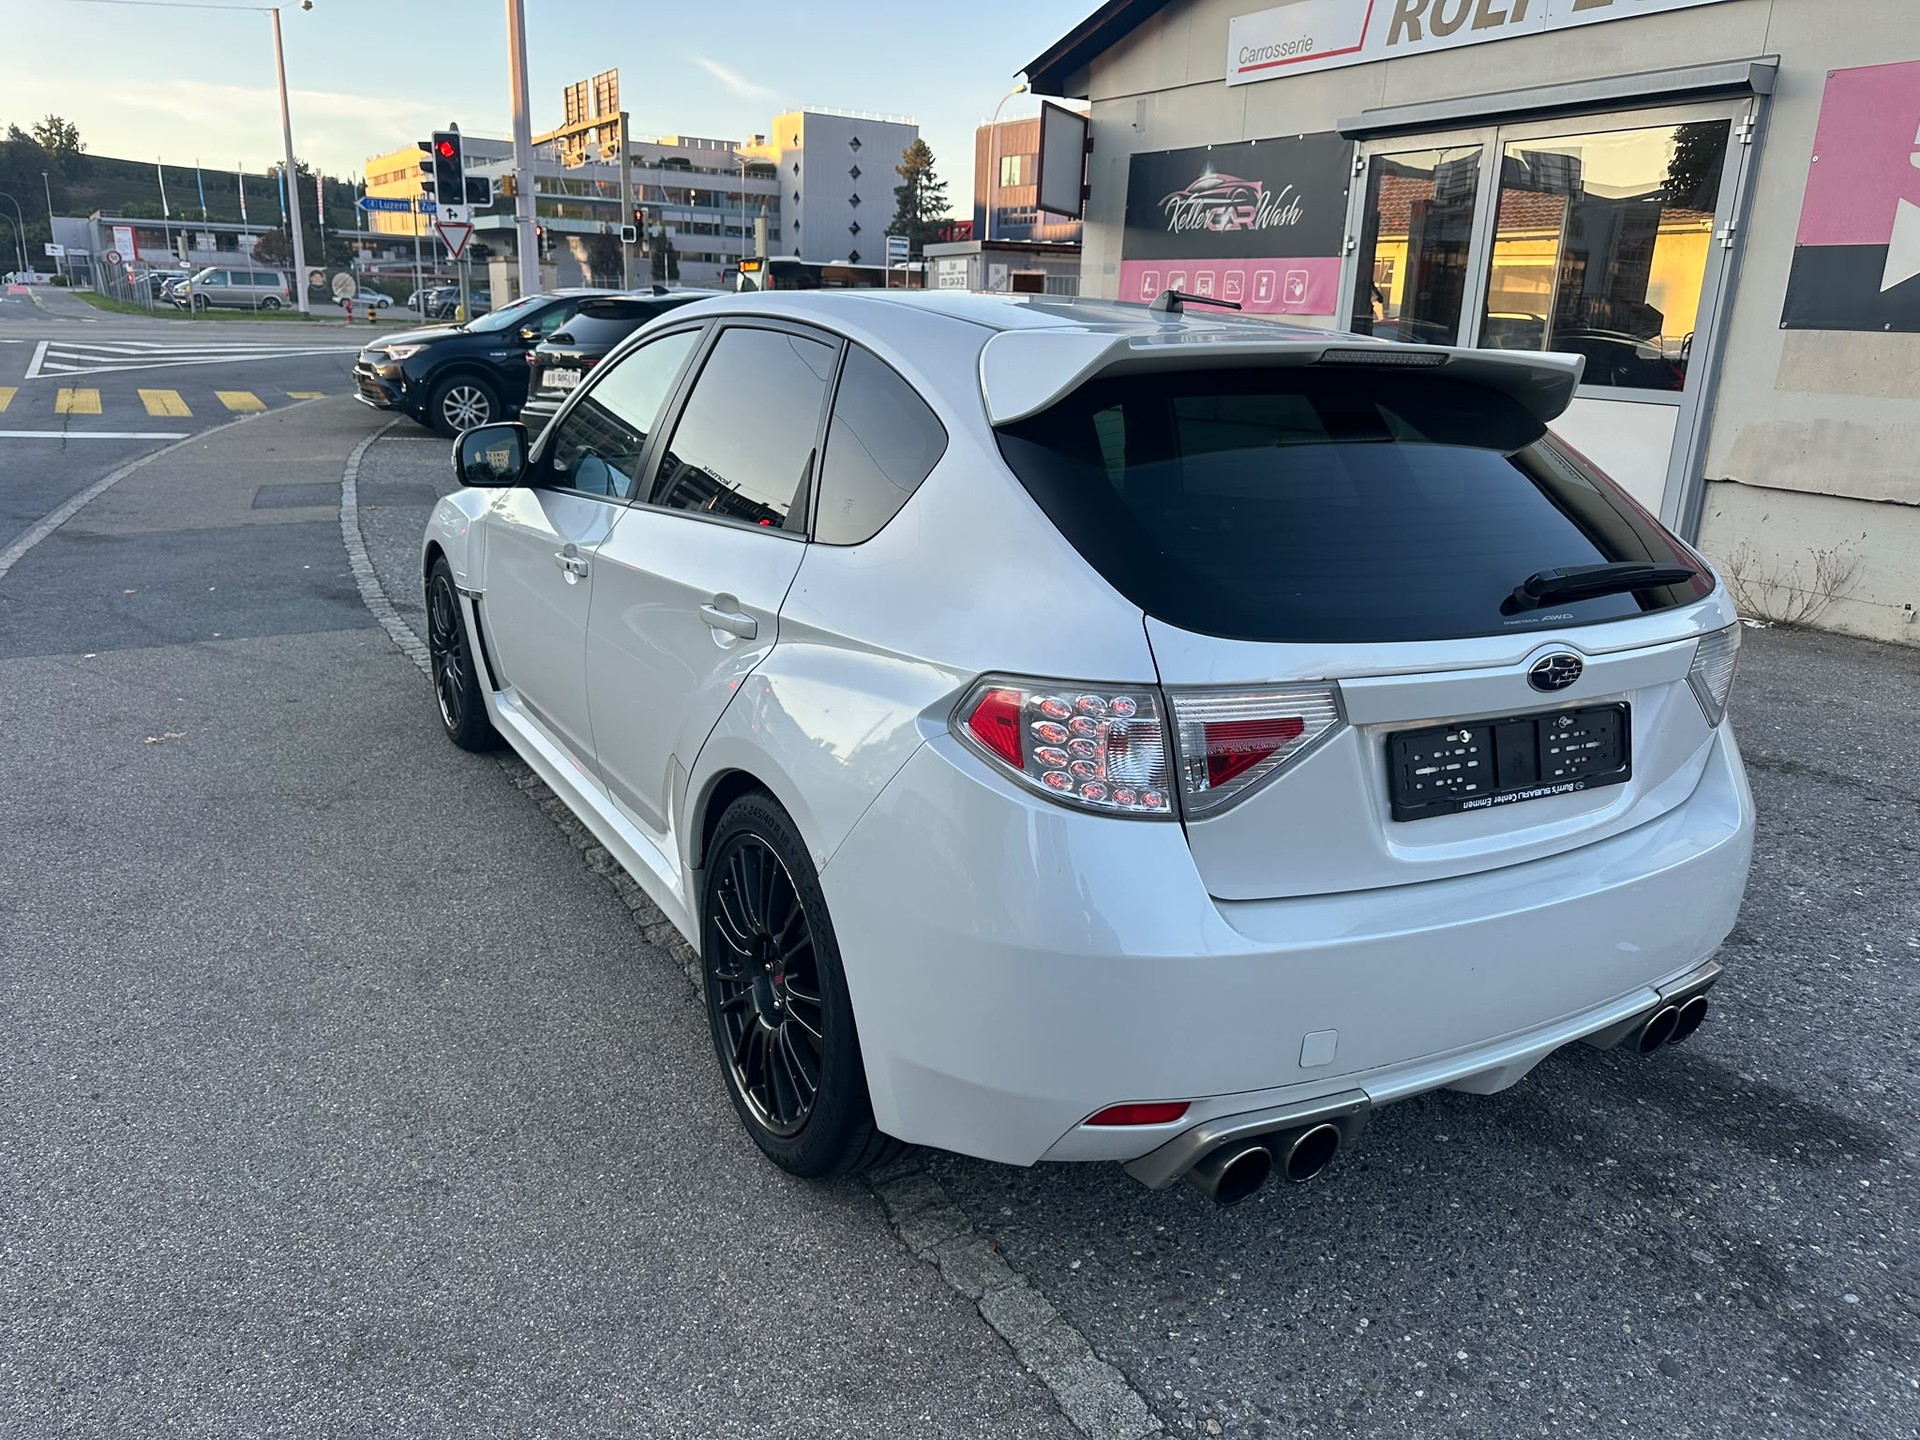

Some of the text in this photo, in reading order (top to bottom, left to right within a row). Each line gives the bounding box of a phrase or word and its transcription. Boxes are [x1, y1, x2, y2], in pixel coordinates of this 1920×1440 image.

[1239, 34, 1313, 64] Carrosserie
[379, 200, 409, 210] Luzern
[1165, 184, 1304, 234] Keller CAR Wash
[1541, 613, 1574, 621] AWD
[1463, 783, 1575, 809] Burri's SUBARU Center Emmen
[748, 806, 775, 828] 245/40
